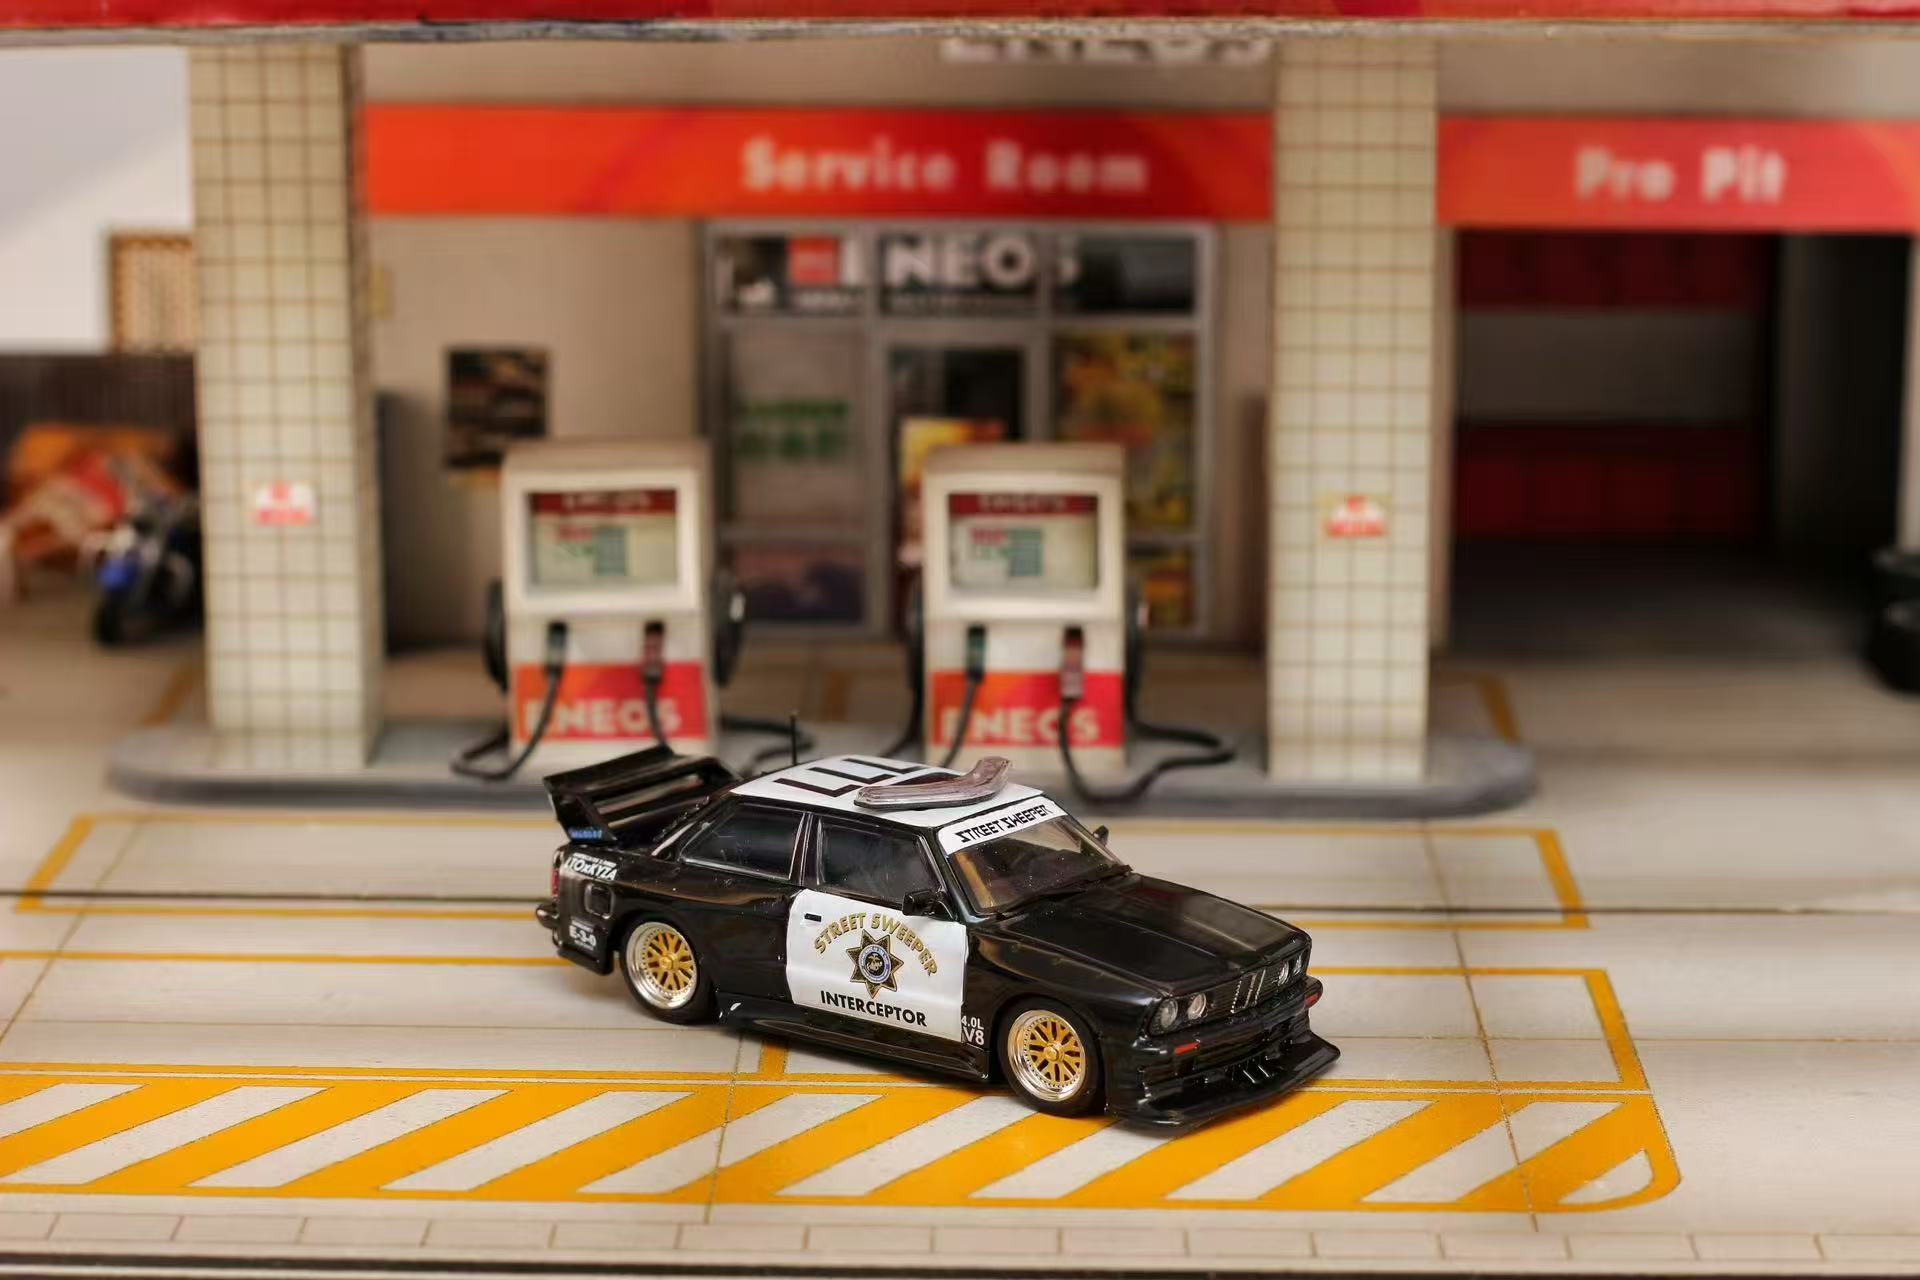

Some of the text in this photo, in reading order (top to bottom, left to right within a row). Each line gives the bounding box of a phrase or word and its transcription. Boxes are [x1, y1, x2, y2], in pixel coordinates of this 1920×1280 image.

[741, 135, 1147, 192] Service Room
[1577, 146, 1786, 201] Pro Pit
[955, 804, 1054, 843] STREET SWEEPER
[814, 912, 867, 955] STREET
[871, 912, 938, 977] SWEEPER
[820, 990, 928, 1028] INTERCEPTOR
[961, 1015, 985, 1030] 4.0L
[963, 1026, 985, 1046] V8
